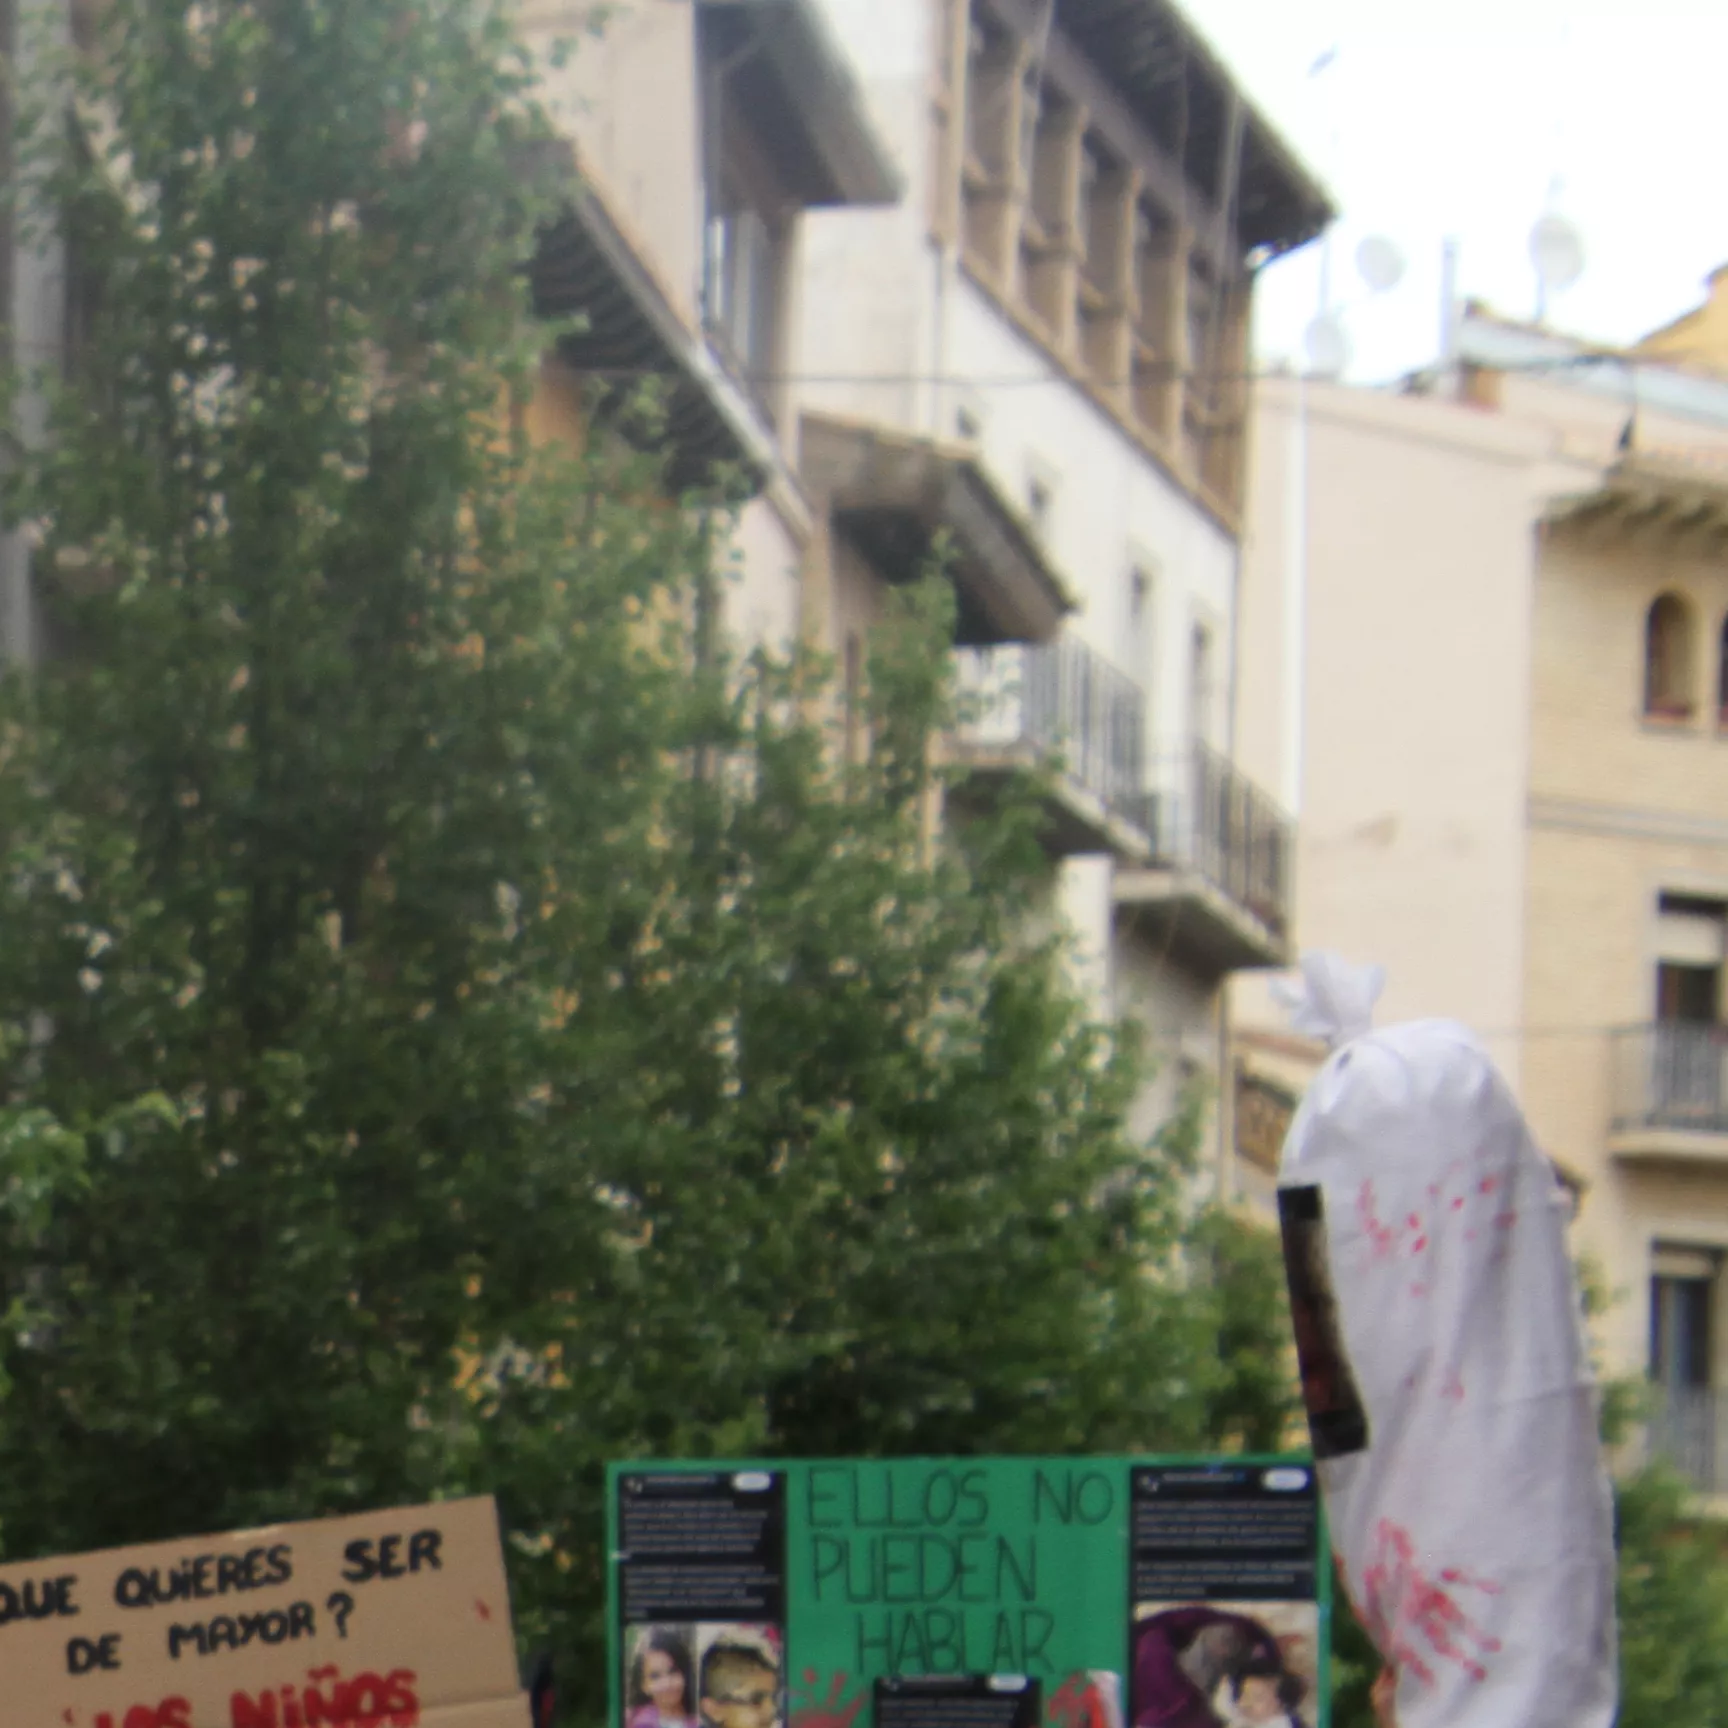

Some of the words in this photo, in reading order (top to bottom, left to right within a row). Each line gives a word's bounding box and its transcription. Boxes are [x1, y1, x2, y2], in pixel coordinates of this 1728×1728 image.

[808, 1467, 988, 1528] ELLOS
[1034, 1468, 1114, 1525] NO
[341, 1529, 442, 1582] SER
[812, 1532, 1036, 1603] PUEDEN
[66, 1633, 122, 1674] DE
[854, 1606, 1056, 1677] HABLAR
